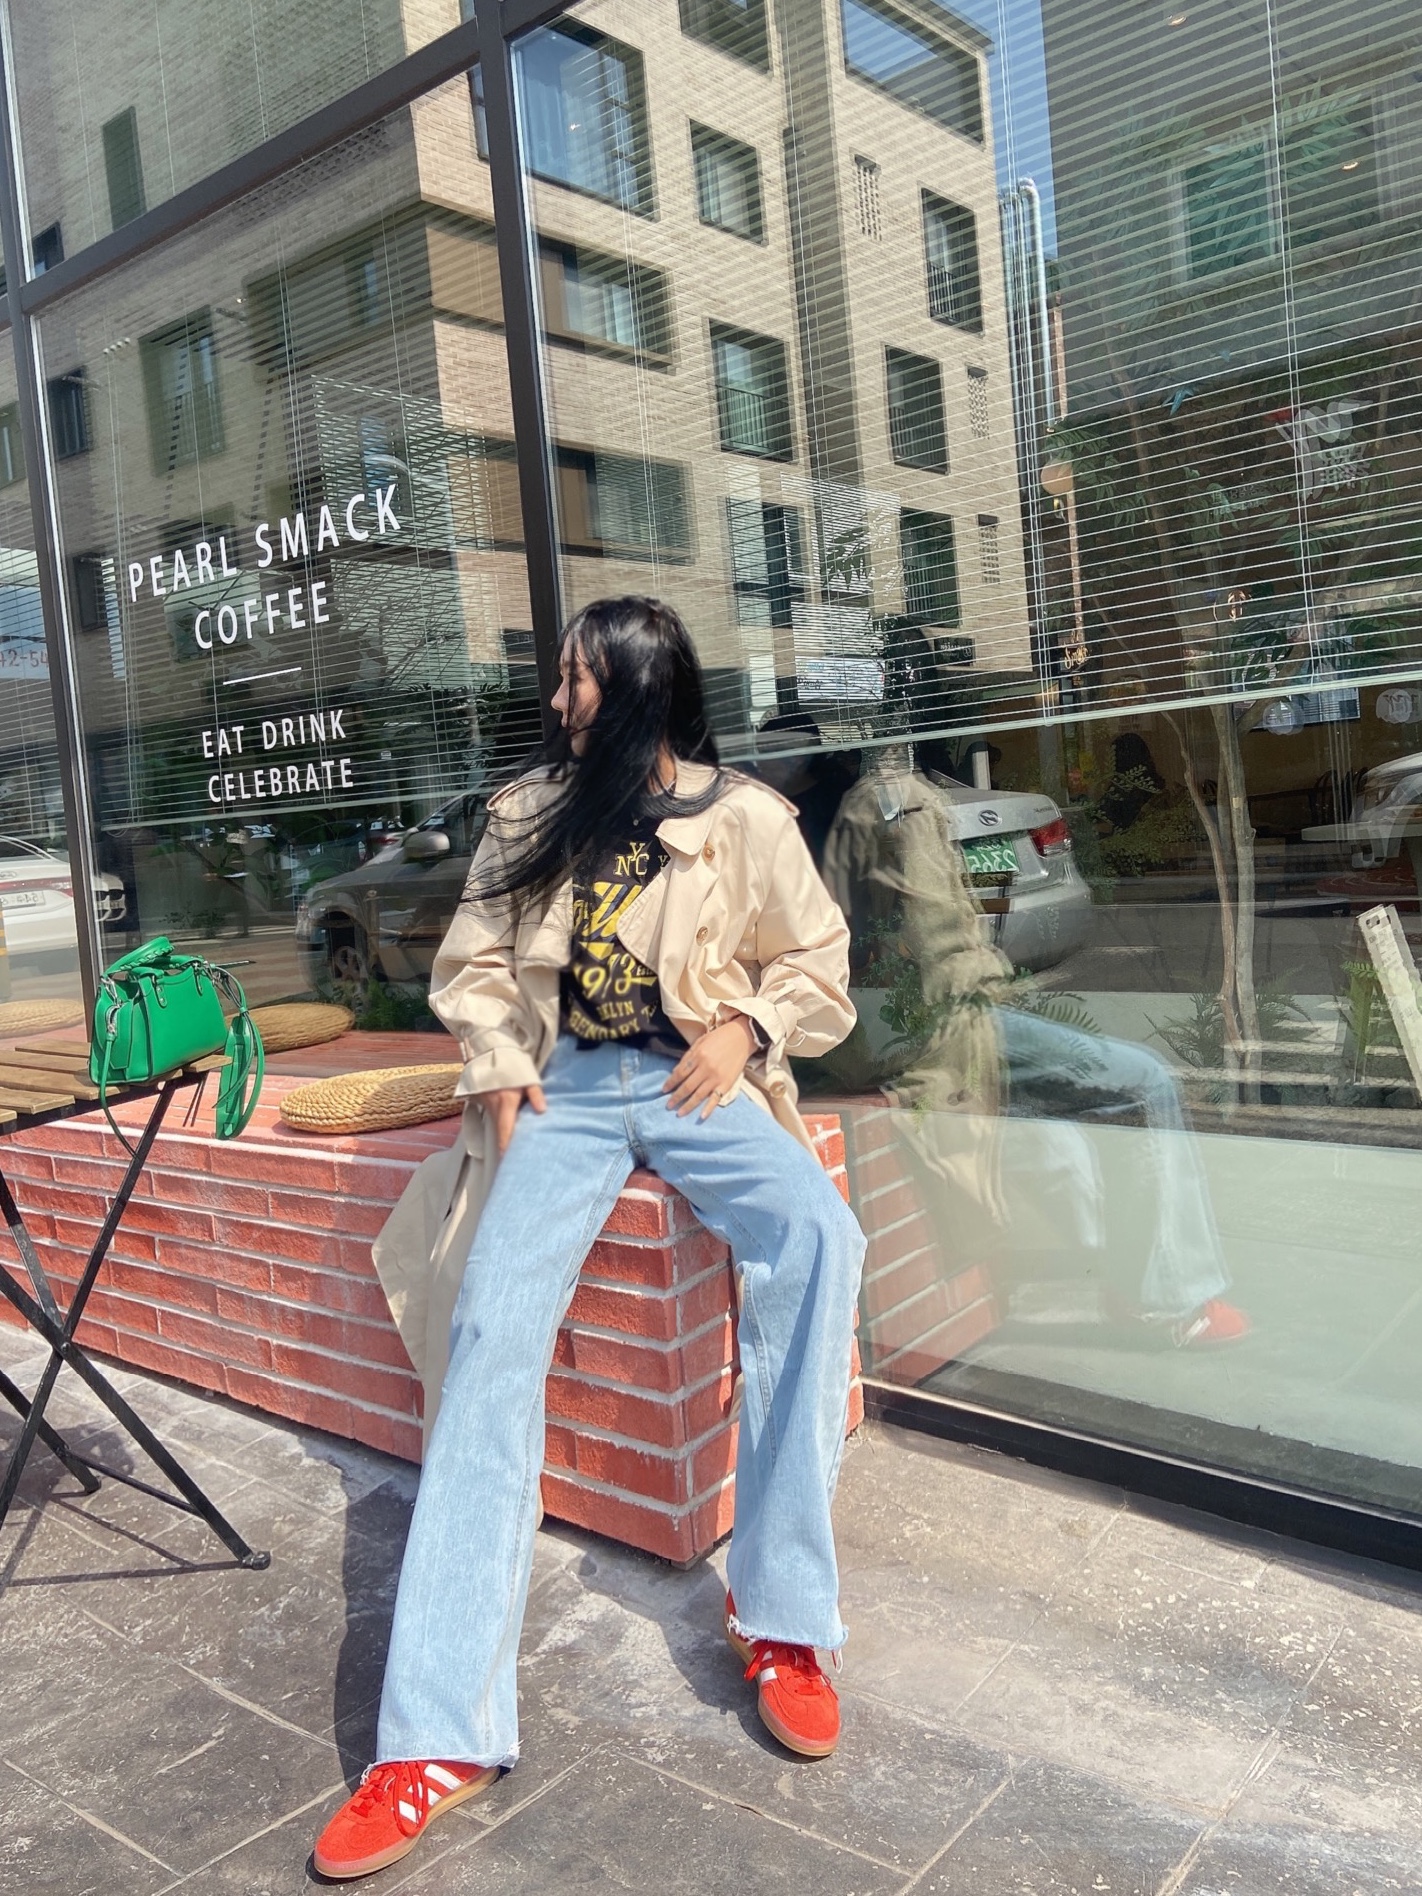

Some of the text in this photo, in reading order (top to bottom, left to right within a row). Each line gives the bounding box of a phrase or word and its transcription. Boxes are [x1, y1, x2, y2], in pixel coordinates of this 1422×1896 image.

[128, 483, 401, 602] PEARL SMACK
[194, 581, 330, 650] COFFEE
[202, 709, 346, 758] EAT DRINK
[208, 758, 354, 803] CELEBRATE
